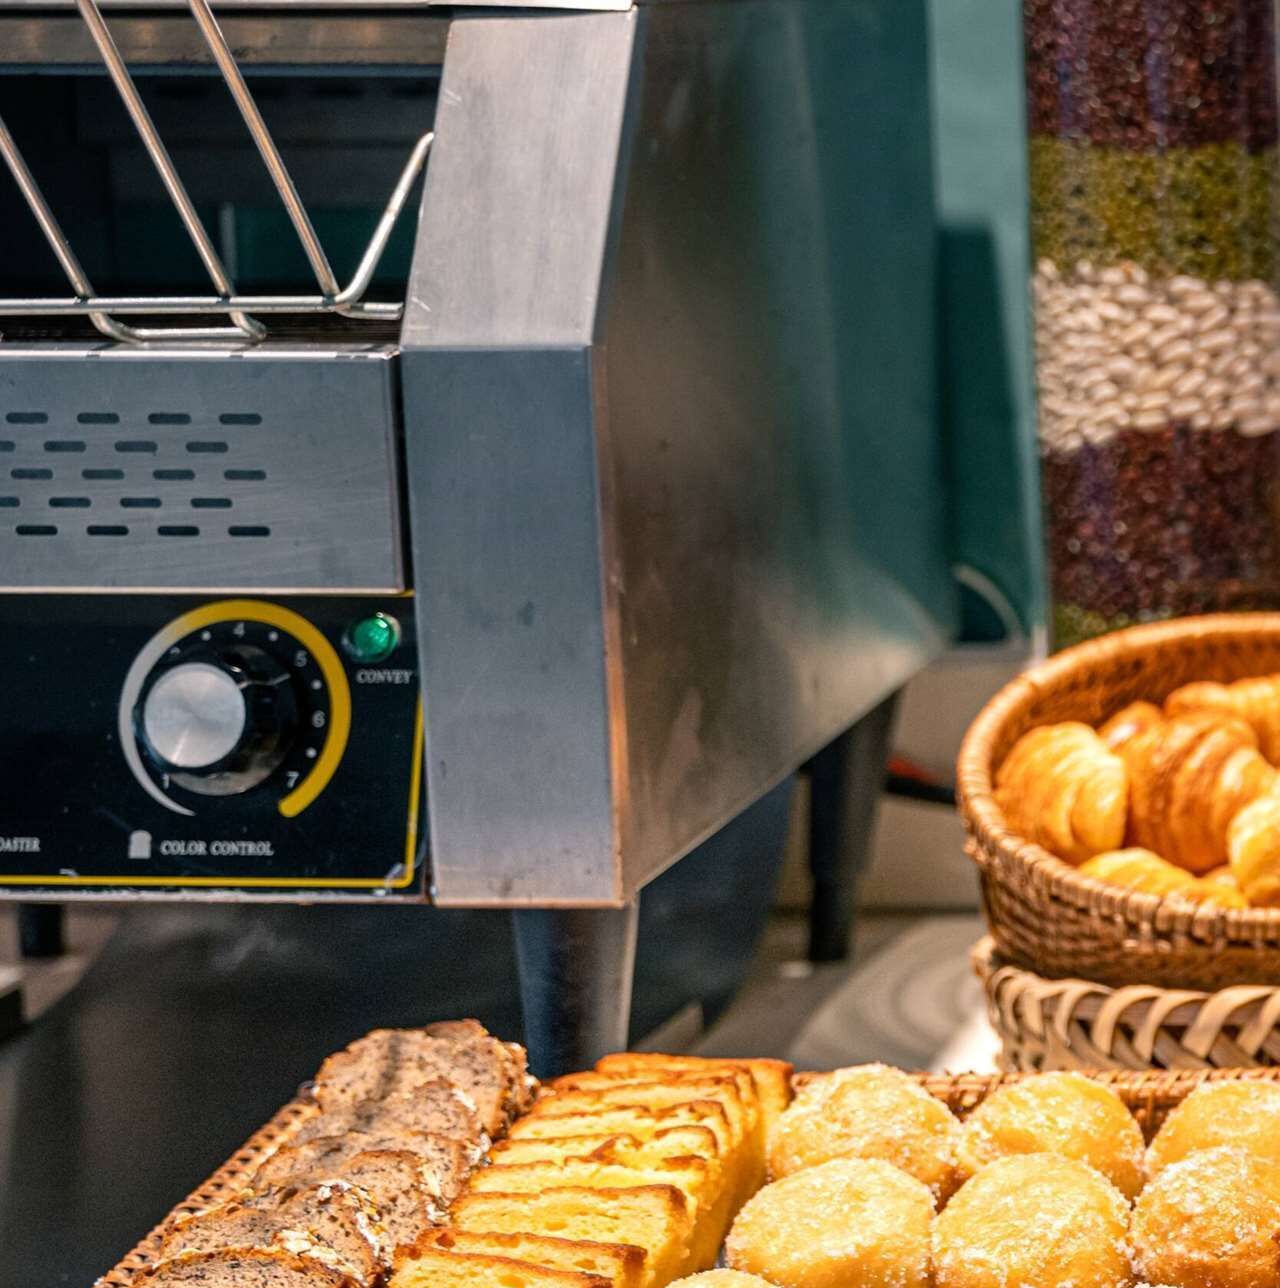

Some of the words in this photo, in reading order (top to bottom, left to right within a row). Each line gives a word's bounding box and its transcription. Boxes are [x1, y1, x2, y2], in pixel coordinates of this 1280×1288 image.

[233, 623, 245, 637] 4
[295, 650, 307, 668] 5
[357, 670, 412, 684] CONVEY
[311, 710, 326, 728] 6
[286, 771, 299, 789] 7
[160, 840, 206, 855] COLOR
[210, 841, 274, 856] CONTROL
